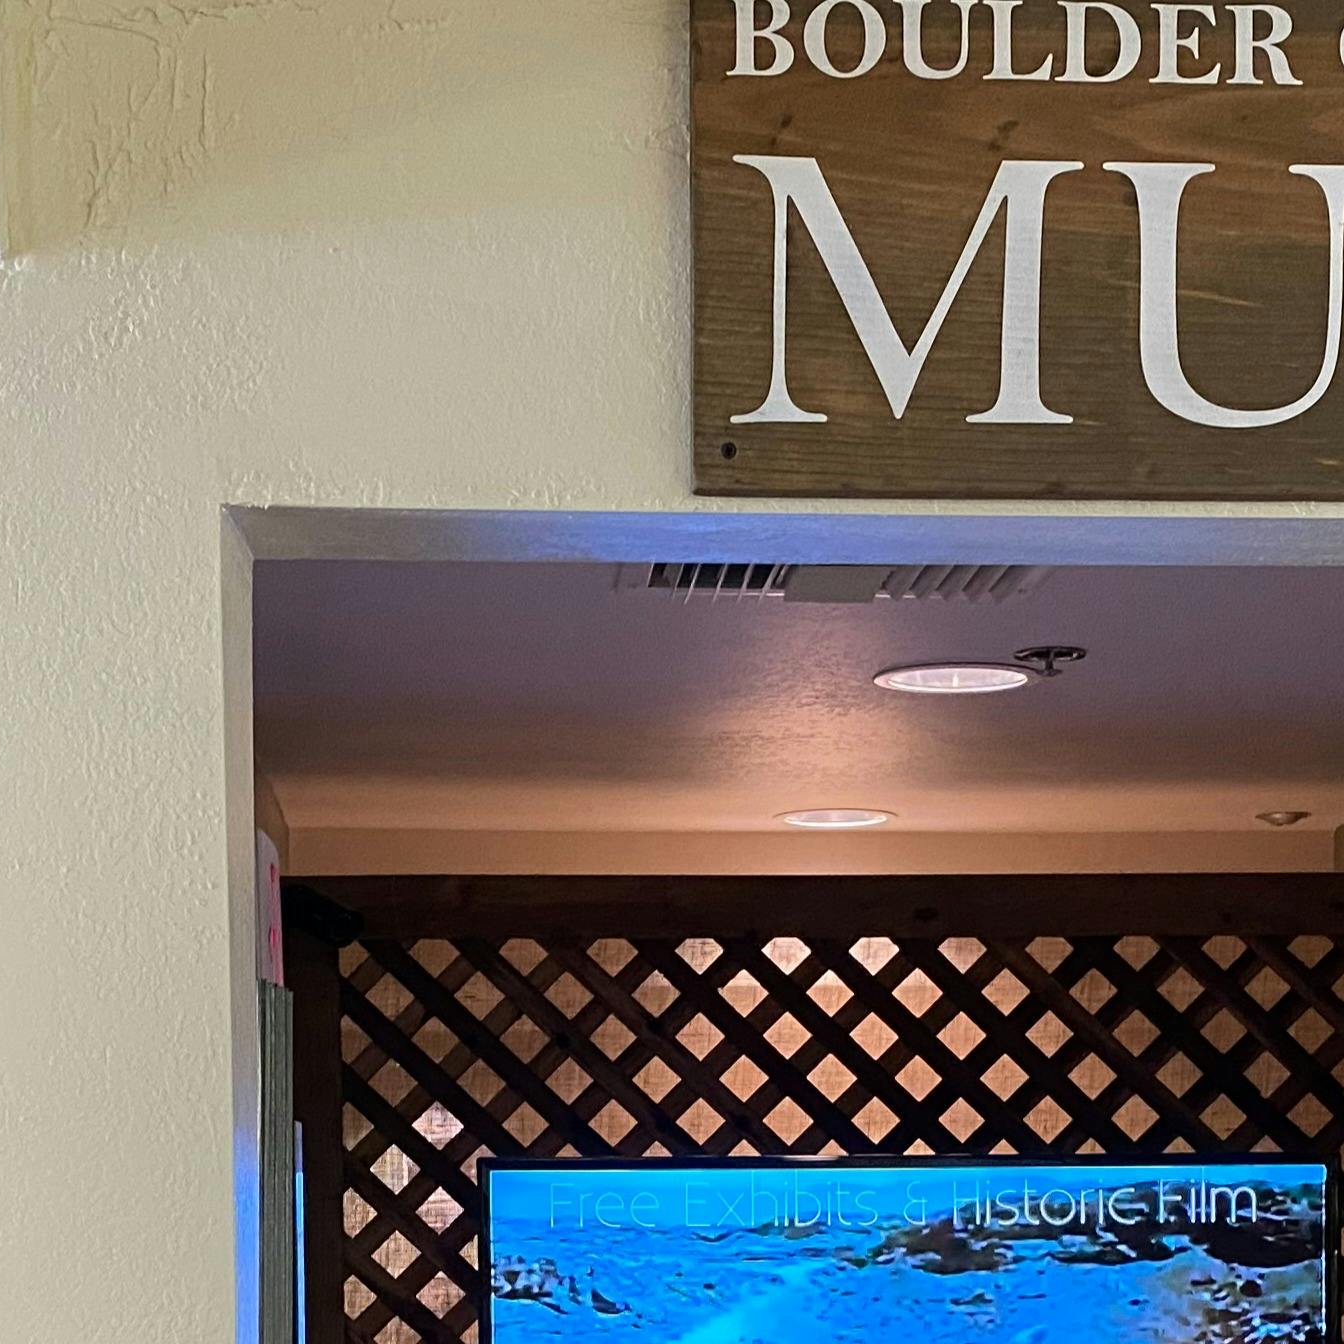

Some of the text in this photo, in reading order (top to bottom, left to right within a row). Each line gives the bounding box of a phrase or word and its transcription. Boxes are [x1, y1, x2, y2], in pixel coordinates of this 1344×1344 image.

[726, 0, 1303, 86] BOULDER
[549, 1167, 1258, 1229] Free Exhibits & Historic Film
